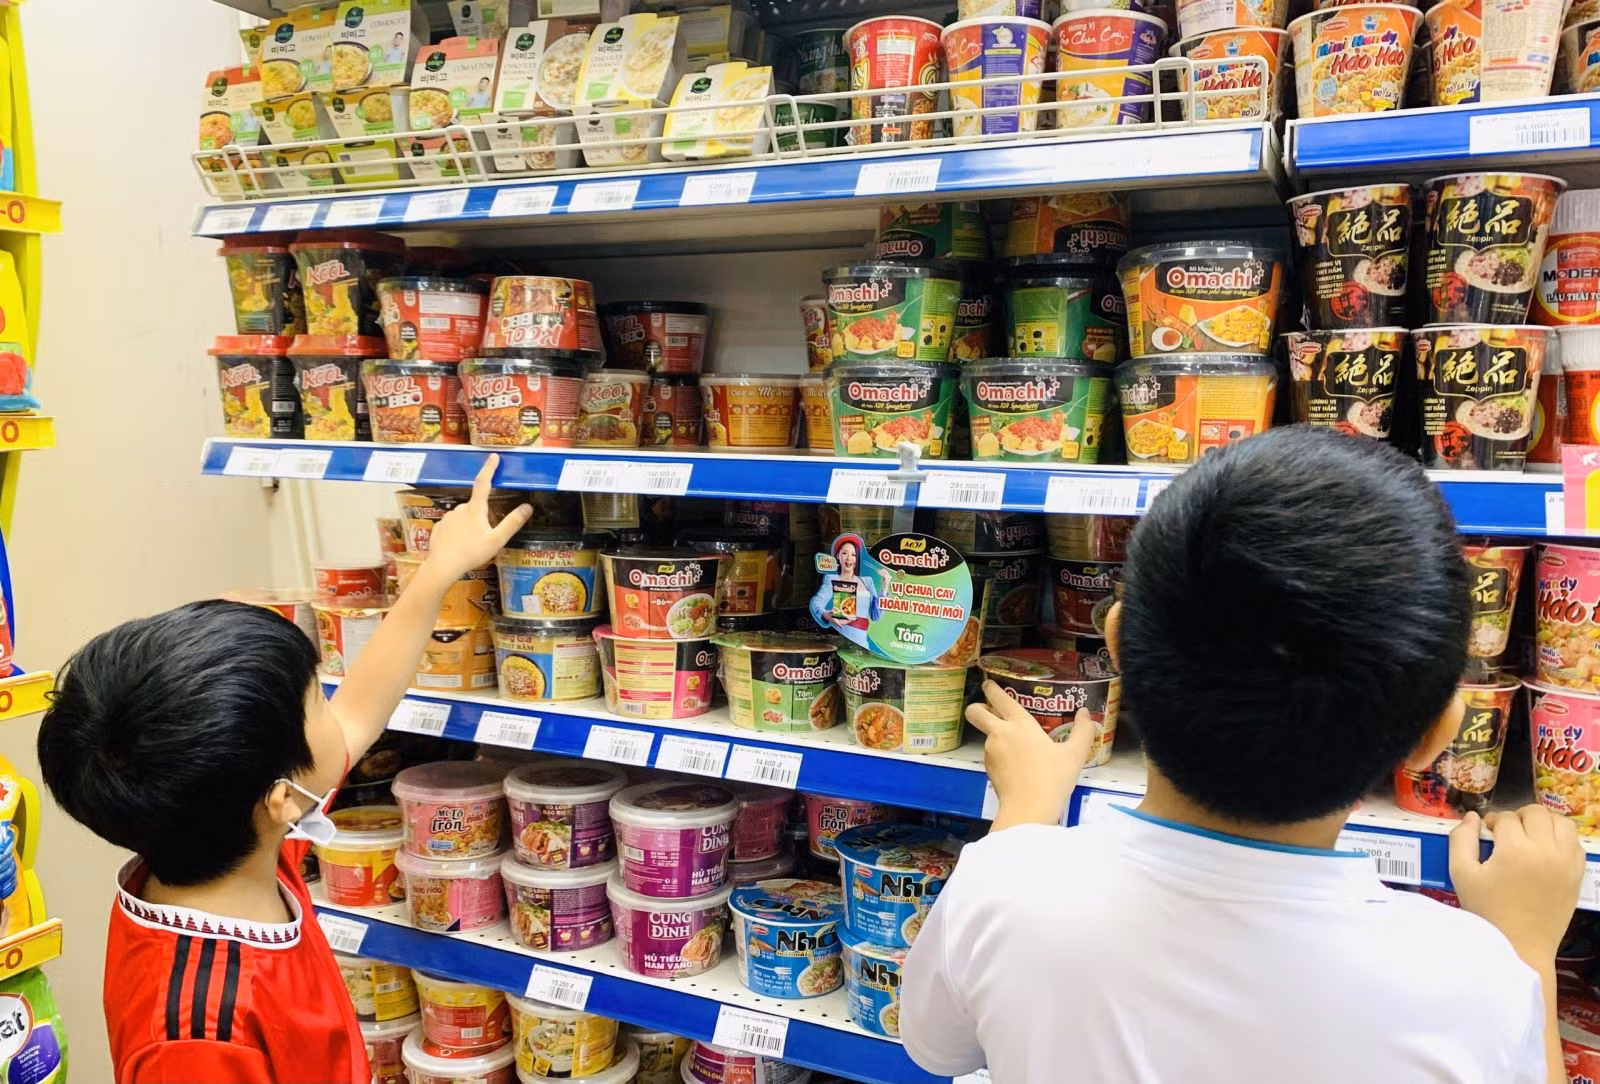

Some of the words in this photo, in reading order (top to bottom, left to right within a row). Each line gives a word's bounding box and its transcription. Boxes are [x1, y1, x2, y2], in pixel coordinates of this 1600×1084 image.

[1465, 234, 1494, 244] Zeppin
[305, 261, 350, 286] KOOL
[1166, 266, 1253, 290] Omachi
[621, 328, 646, 345] BBQ
[222, 365, 261, 388] KOOL
[302, 365, 348, 388] KOOL
[366, 375, 422, 399] KOOL
[467, 375, 521, 399] KOOL
[848, 381, 919, 402] Omachi
[976, 381, 1047, 402] Omachi
[1465, 385, 1493, 394] Zeppin
[879, 549, 939, 569] Omachi
[629, 568, 694, 588] Omachi
[1060, 570, 1113, 589] Omach
[1539, 576, 1578, 592] Handy
[890, 582, 904, 597] VỊ
[904, 584, 934, 598] CHUA
[934, 588, 957, 601] CAY
[878, 597, 909, 612] HOÀN
[911, 601, 941, 616] TOÀN
[1537, 590, 1587, 625] Hảo
[896, 627, 924, 644] Tôm
[772, 661, 834, 681] Omachi
[1538, 725, 1583, 741] Handy
[1536, 737, 1594, 774] Hảo
[431, 819, 466, 833] trộn
[649, 911, 692, 926] CUNG
[651, 924, 691, 938] ĐÌNH
[644, 961, 665, 970] NAM
[860, 957, 902, 988] Nh
